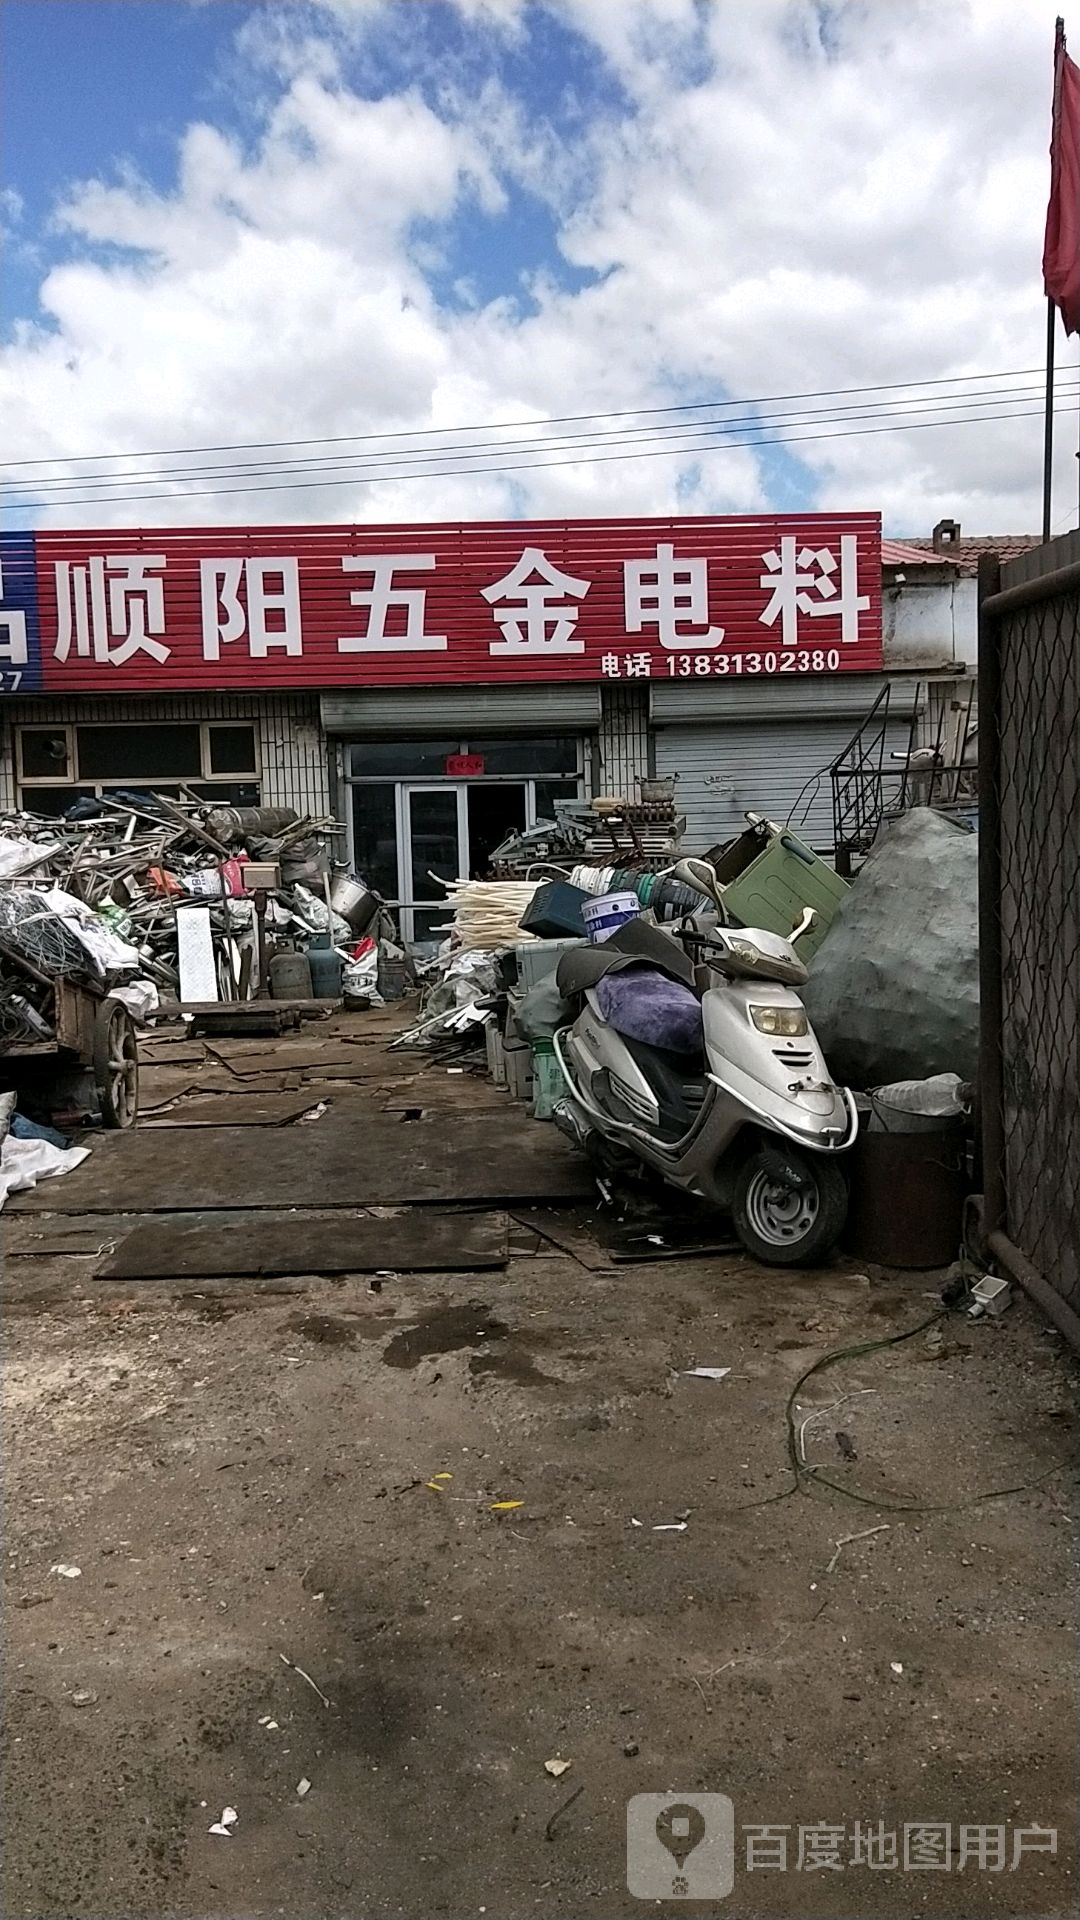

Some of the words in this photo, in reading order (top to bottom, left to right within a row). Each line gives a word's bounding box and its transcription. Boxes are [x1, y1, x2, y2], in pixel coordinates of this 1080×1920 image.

[53, 535, 871, 667] 顺阳五金电料
[601, 651, 652, 678] 电话
[666, 649, 840, 677] 13831302380
